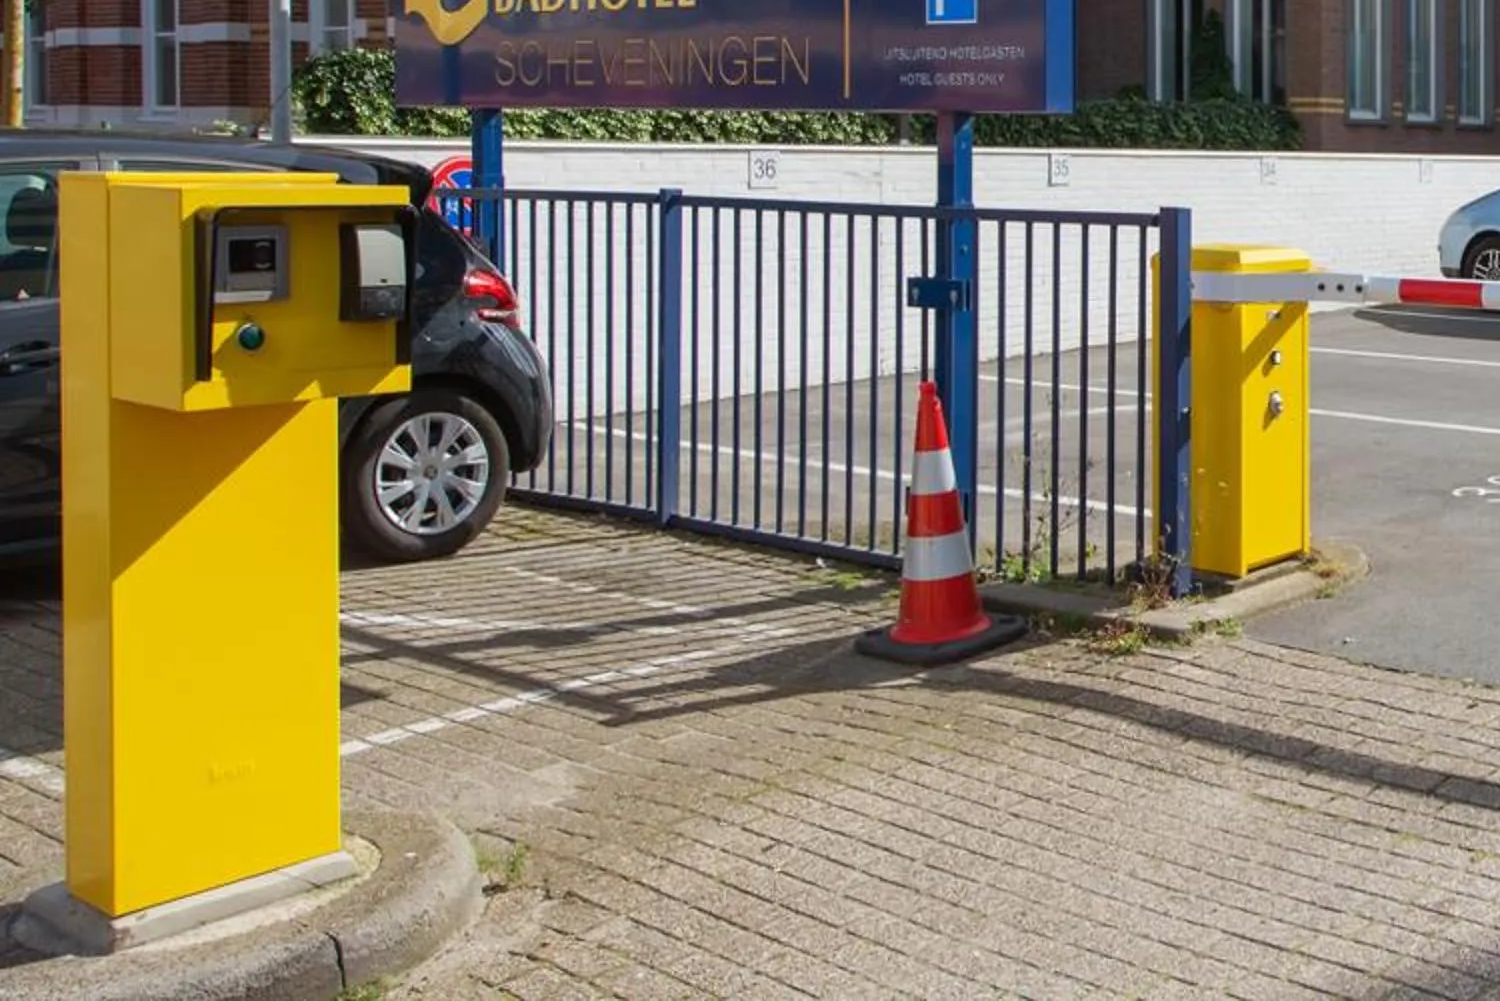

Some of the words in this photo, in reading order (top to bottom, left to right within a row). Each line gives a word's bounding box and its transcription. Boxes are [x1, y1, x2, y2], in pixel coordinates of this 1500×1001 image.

[494, 35, 811, 87] SCHEVENINGEN
[900, 72, 931, 87] HOTEL
[933, 72, 975, 86] GUESTS
[977, 72, 1005, 86] ONLY
[753, 157, 777, 180] 36
[1053, 158, 1070, 177] 35
